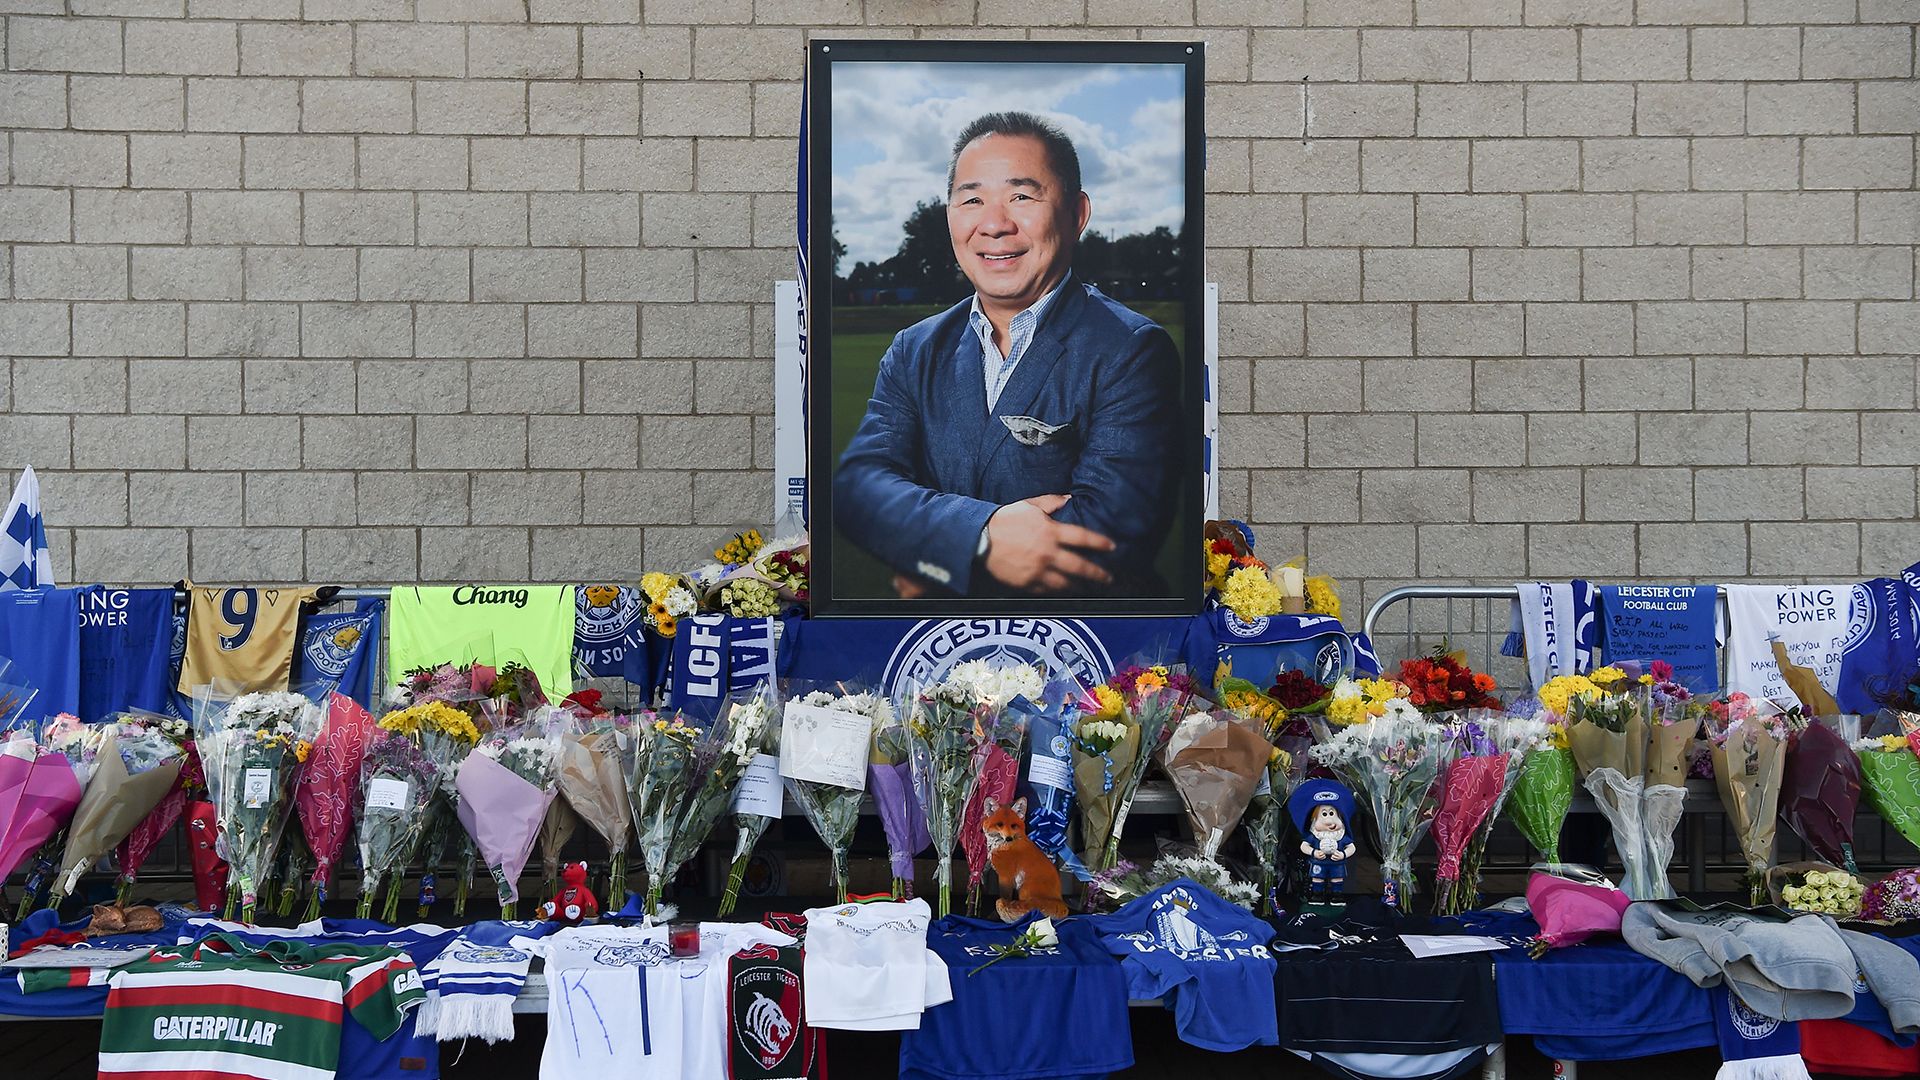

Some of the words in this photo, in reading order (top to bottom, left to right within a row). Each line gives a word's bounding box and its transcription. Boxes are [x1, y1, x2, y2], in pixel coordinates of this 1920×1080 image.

[80, 590, 130, 610] ING
[453, 584, 529, 609] Chang
[1618, 586, 1670, 598] LEICESTER
[1672, 587, 1697, 598] CITY
[1776, 589, 1835, 611] KING
[1540, 583, 1556, 647] ESTER
[1623, 600, 1665, 611] FOOTBALL
[1666, 602, 1688, 611] CLUB
[1778, 607, 1837, 625] POWER
[79, 611, 128, 627] OWER
[217, 584, 258, 651] 9
[907, 618, 1053, 687] EICESTER
[740, 972, 771, 987] LEICESTER
[776, 974, 796, 987] TIGERS
[153, 1016, 277, 1047] CATERPILLAR
